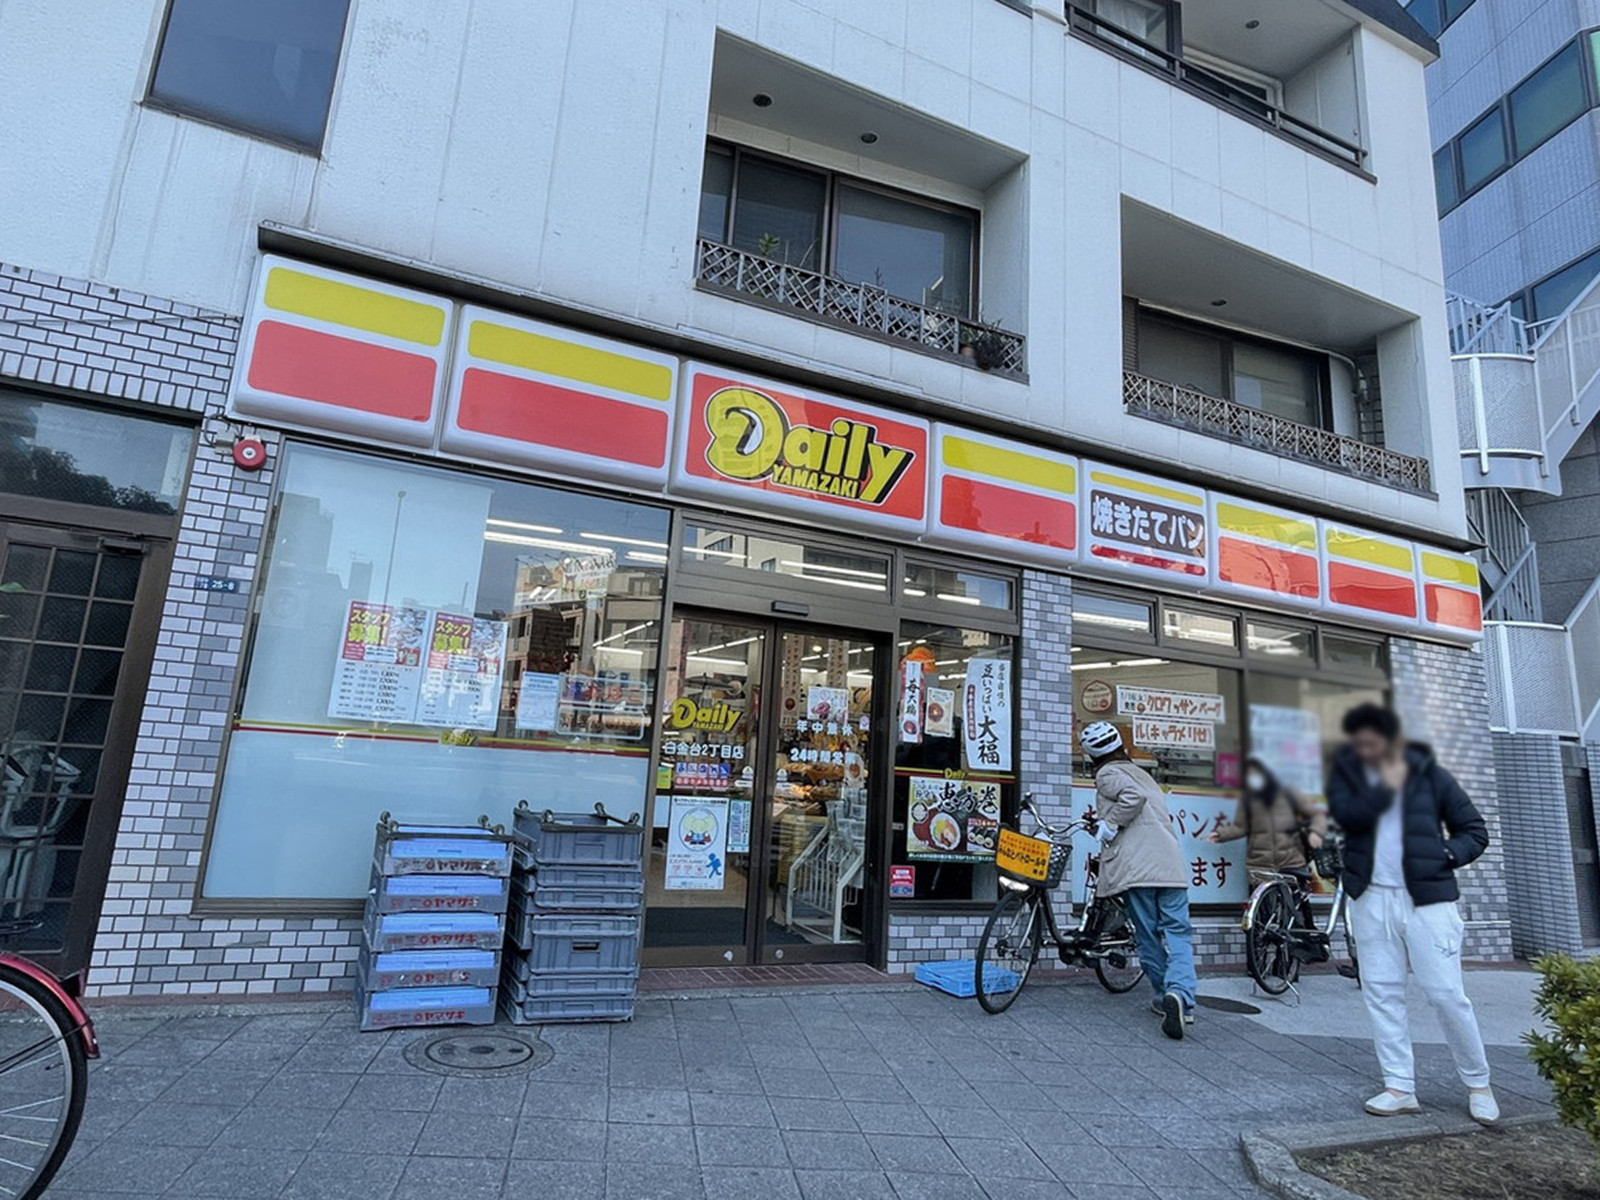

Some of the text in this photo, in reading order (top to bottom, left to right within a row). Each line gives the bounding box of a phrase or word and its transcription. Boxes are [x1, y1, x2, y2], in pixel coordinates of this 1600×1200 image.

[705, 386, 915, 504] Daily
[772, 463, 860, 499] YAMAZAKI
[1092, 495, 1204, 549] 焼きたてパン
[351, 608, 391, 625] スタッフ
[436, 620, 471, 636] スタッフ
[672, 697, 743, 732] Daily
[796, 719, 853, 737] 年中無休
[936, 781, 999, 815] 恵方巻
